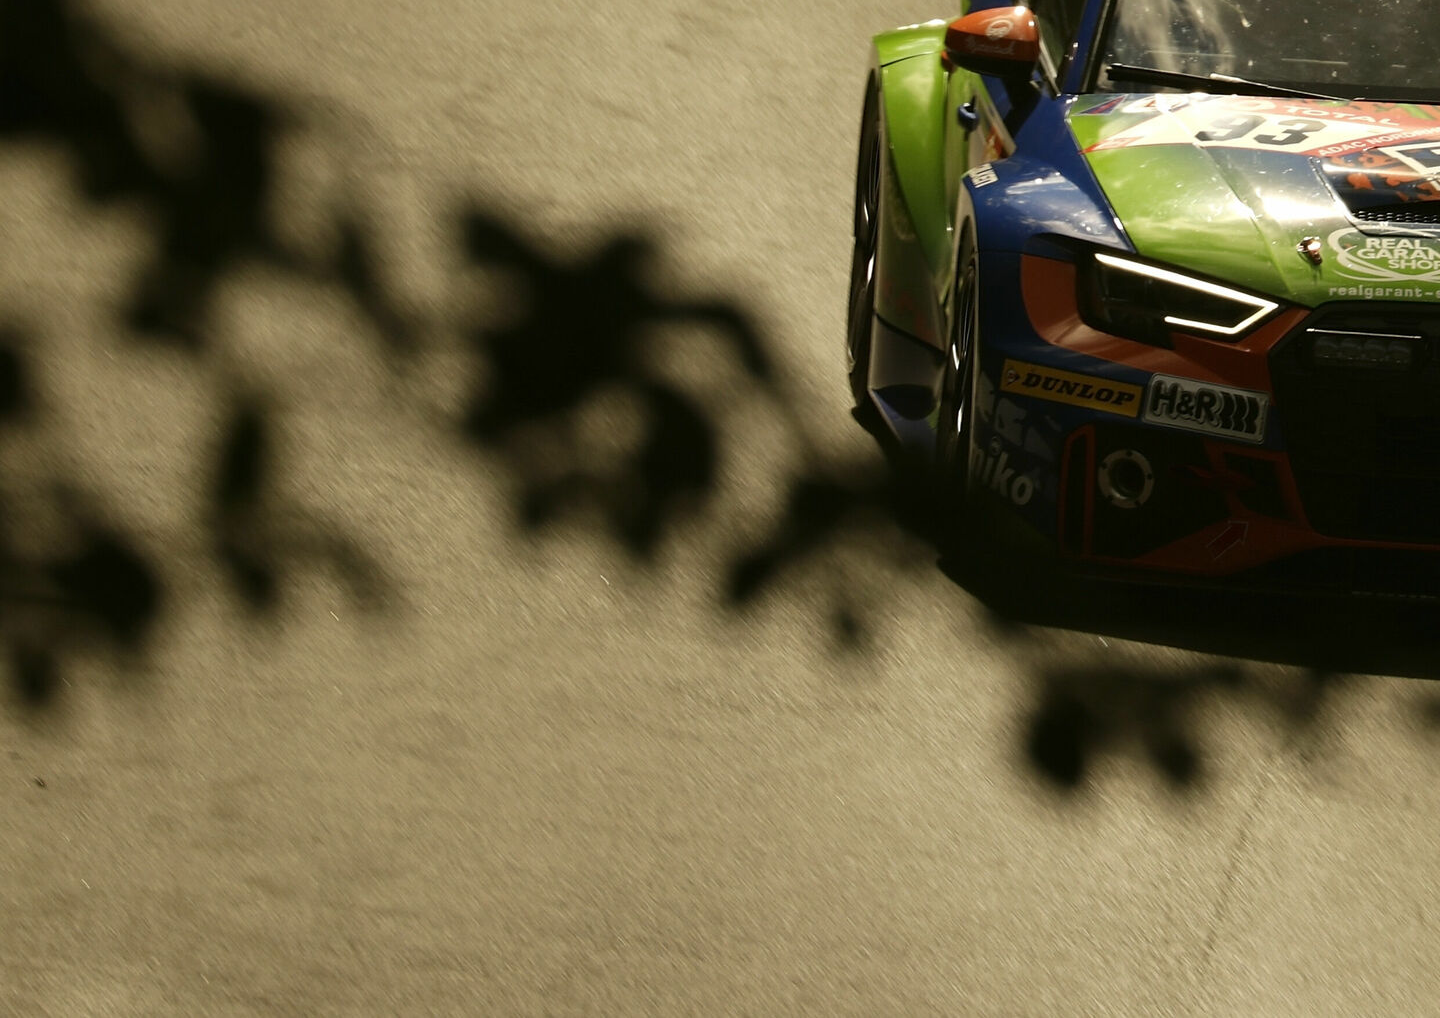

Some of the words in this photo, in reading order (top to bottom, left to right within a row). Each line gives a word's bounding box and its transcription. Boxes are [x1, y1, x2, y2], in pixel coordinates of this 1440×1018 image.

[1283, 105, 1401, 126] TOTAL
[1195, 115, 1327, 146] 93
[1318, 140, 1368, 157] ADAC
[1365, 238, 1431, 250] REAL
[1022, 371, 1136, 407] DUNLOP
